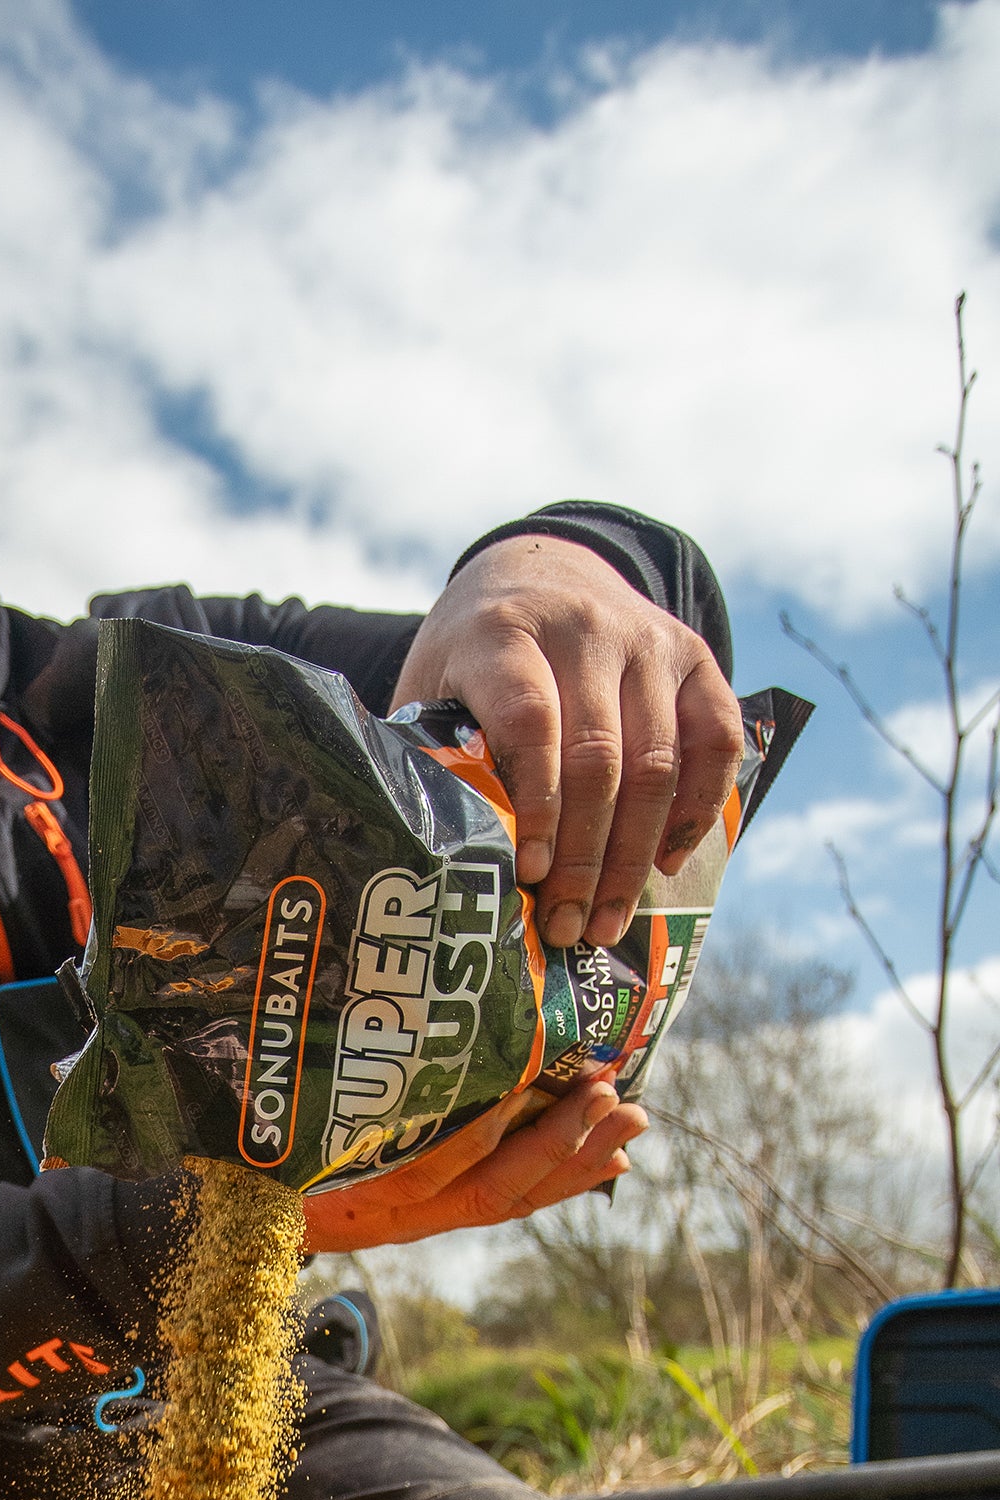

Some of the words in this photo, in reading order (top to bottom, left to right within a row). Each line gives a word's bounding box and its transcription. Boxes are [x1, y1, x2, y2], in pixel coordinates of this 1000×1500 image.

[251, 898, 313, 1147] SONUBAITS
[323, 867, 440, 1173] SUPER
[372, 860, 501, 1168] CRUSH
[543, 1019, 600, 1078] MEGA
[574, 942, 601, 1013] CARP
[555, 1009, 566, 1036] CARP
[594, 946, 614, 986] MIX
